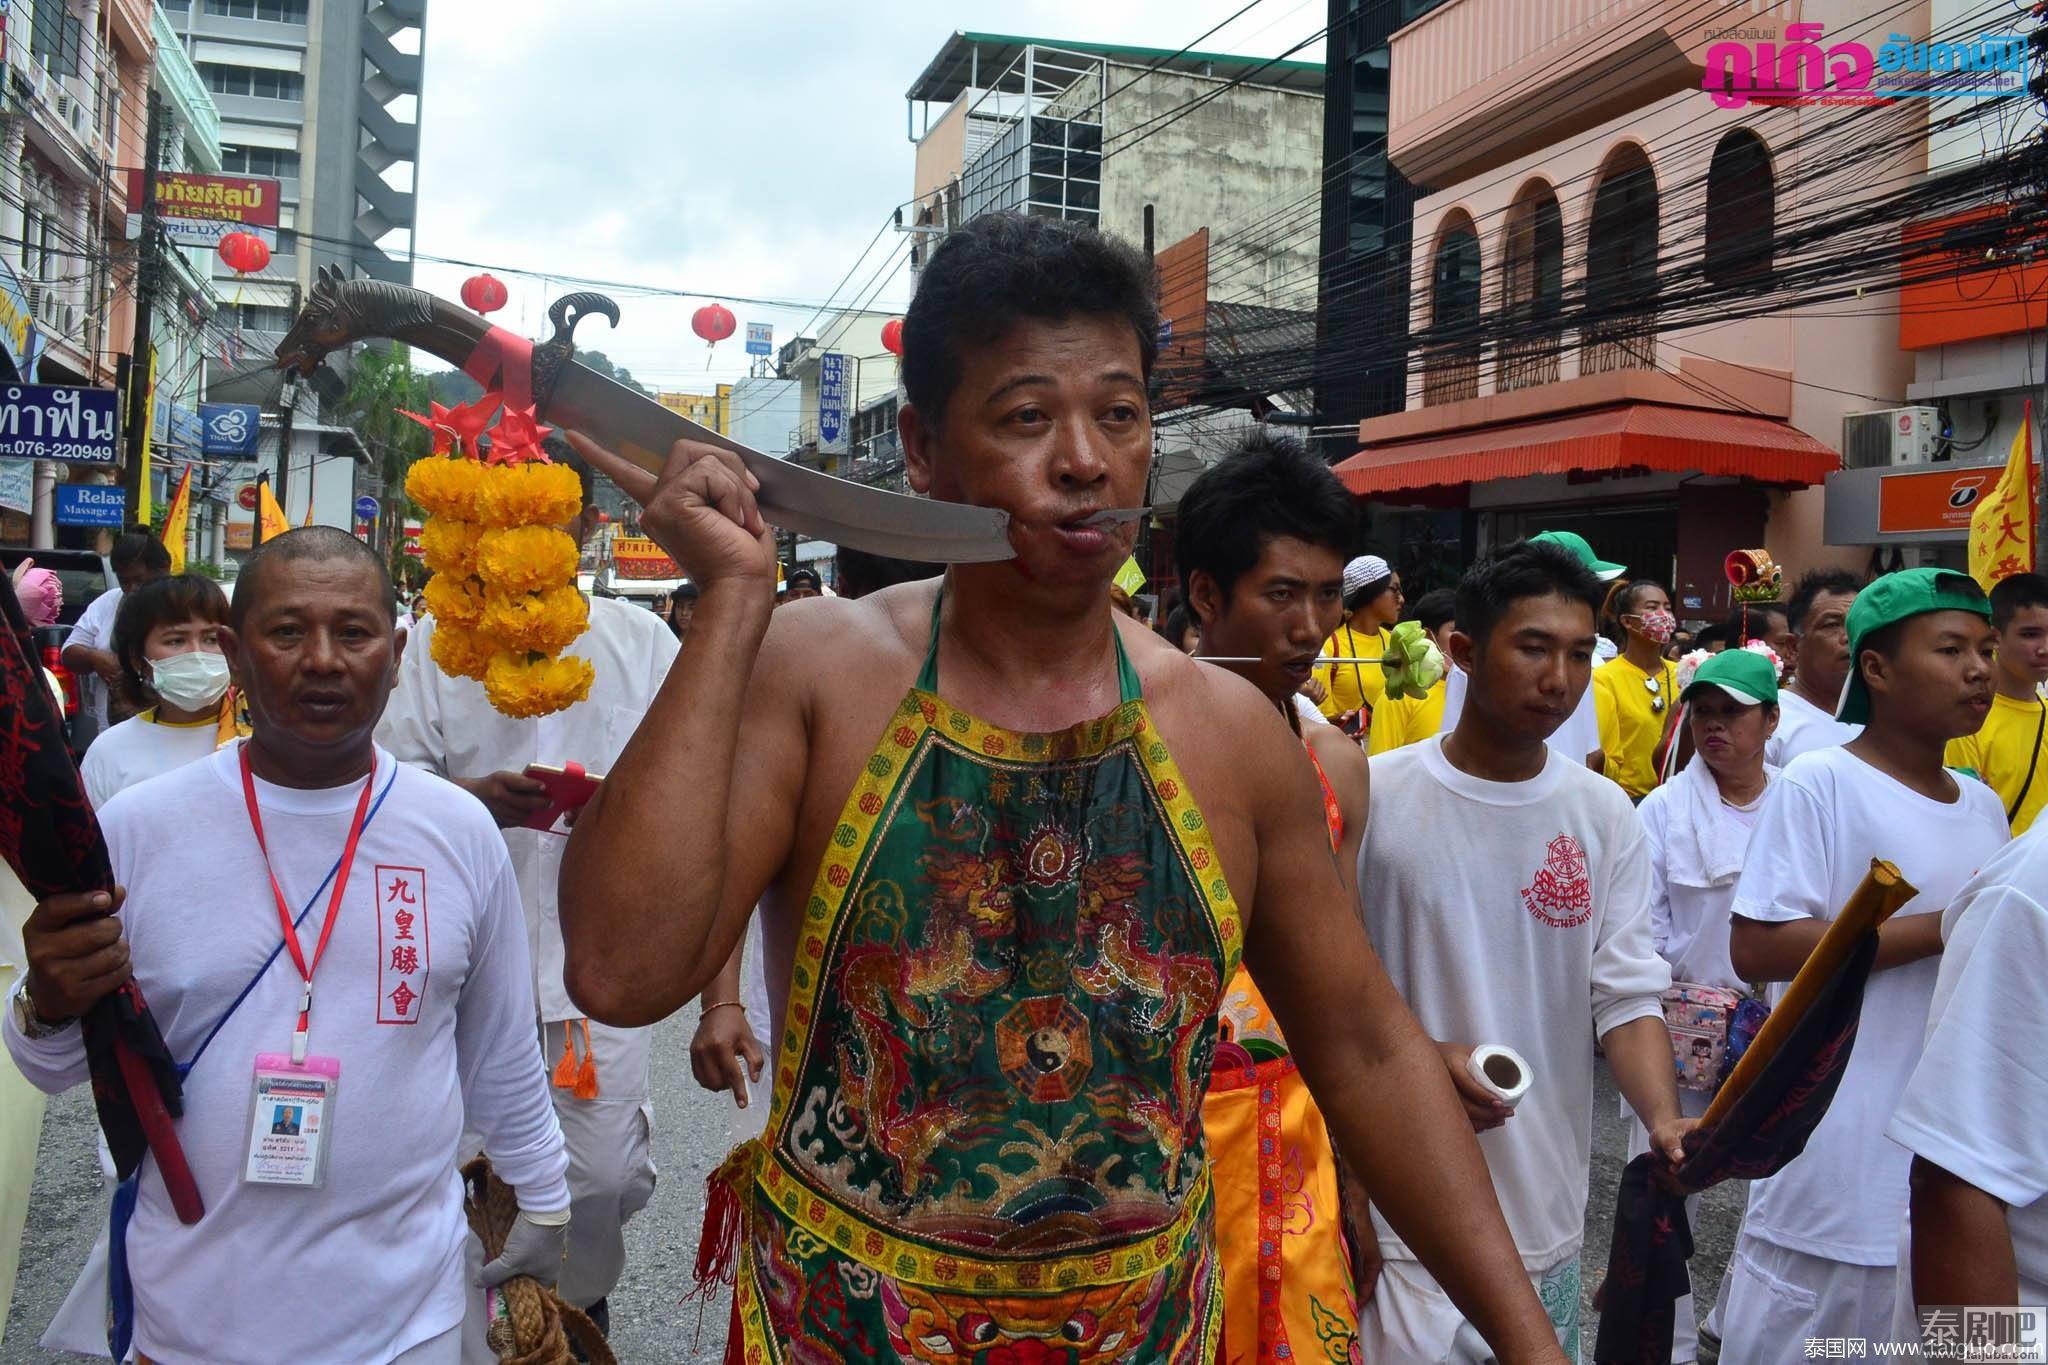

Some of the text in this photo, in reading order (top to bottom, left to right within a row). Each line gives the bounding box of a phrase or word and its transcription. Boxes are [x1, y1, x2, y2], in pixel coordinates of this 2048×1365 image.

[78, 489, 126, 505] Relax
[64, 504, 108, 517] Massage
[387, 877, 419, 1015] 九皇勝會
